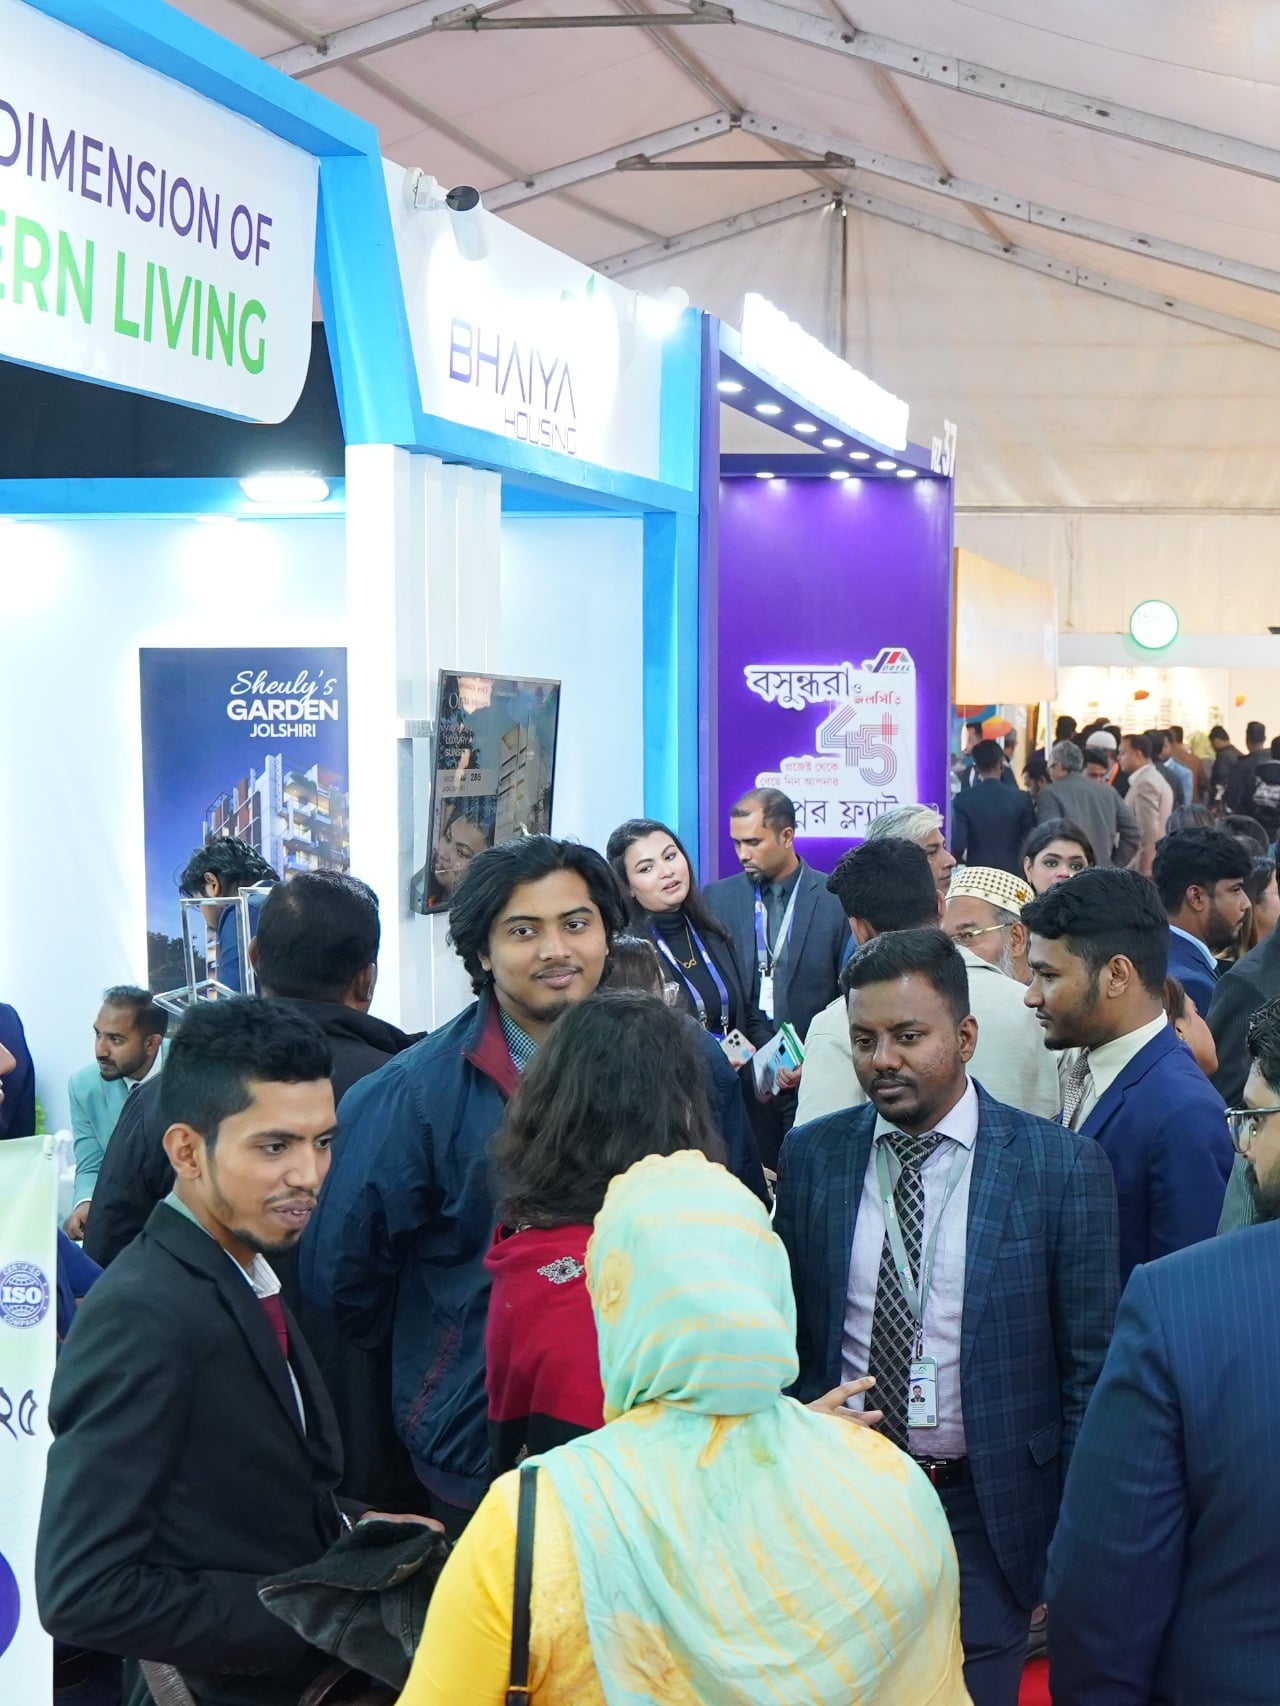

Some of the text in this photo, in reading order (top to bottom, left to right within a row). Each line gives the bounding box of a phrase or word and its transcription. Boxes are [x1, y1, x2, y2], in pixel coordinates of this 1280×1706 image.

[0, 98, 272, 266] DIMENSION OF
[0, 209, 266, 374] RN LIVING
[450, 317, 576, 419] BHAIYA
[504, 407, 577, 455] HOUSING
[230, 669, 337, 705] Sheuly's
[750, 668, 849, 703] বসুন্ধরা
[226, 699, 339, 721] GARDEN
[250, 723, 316, 737] JOLSHIRI
[470, 773, 482, 781] 285
[2, 1286, 42, 1305] ISO
[3, 1314, 41, 1327] COMPANY
